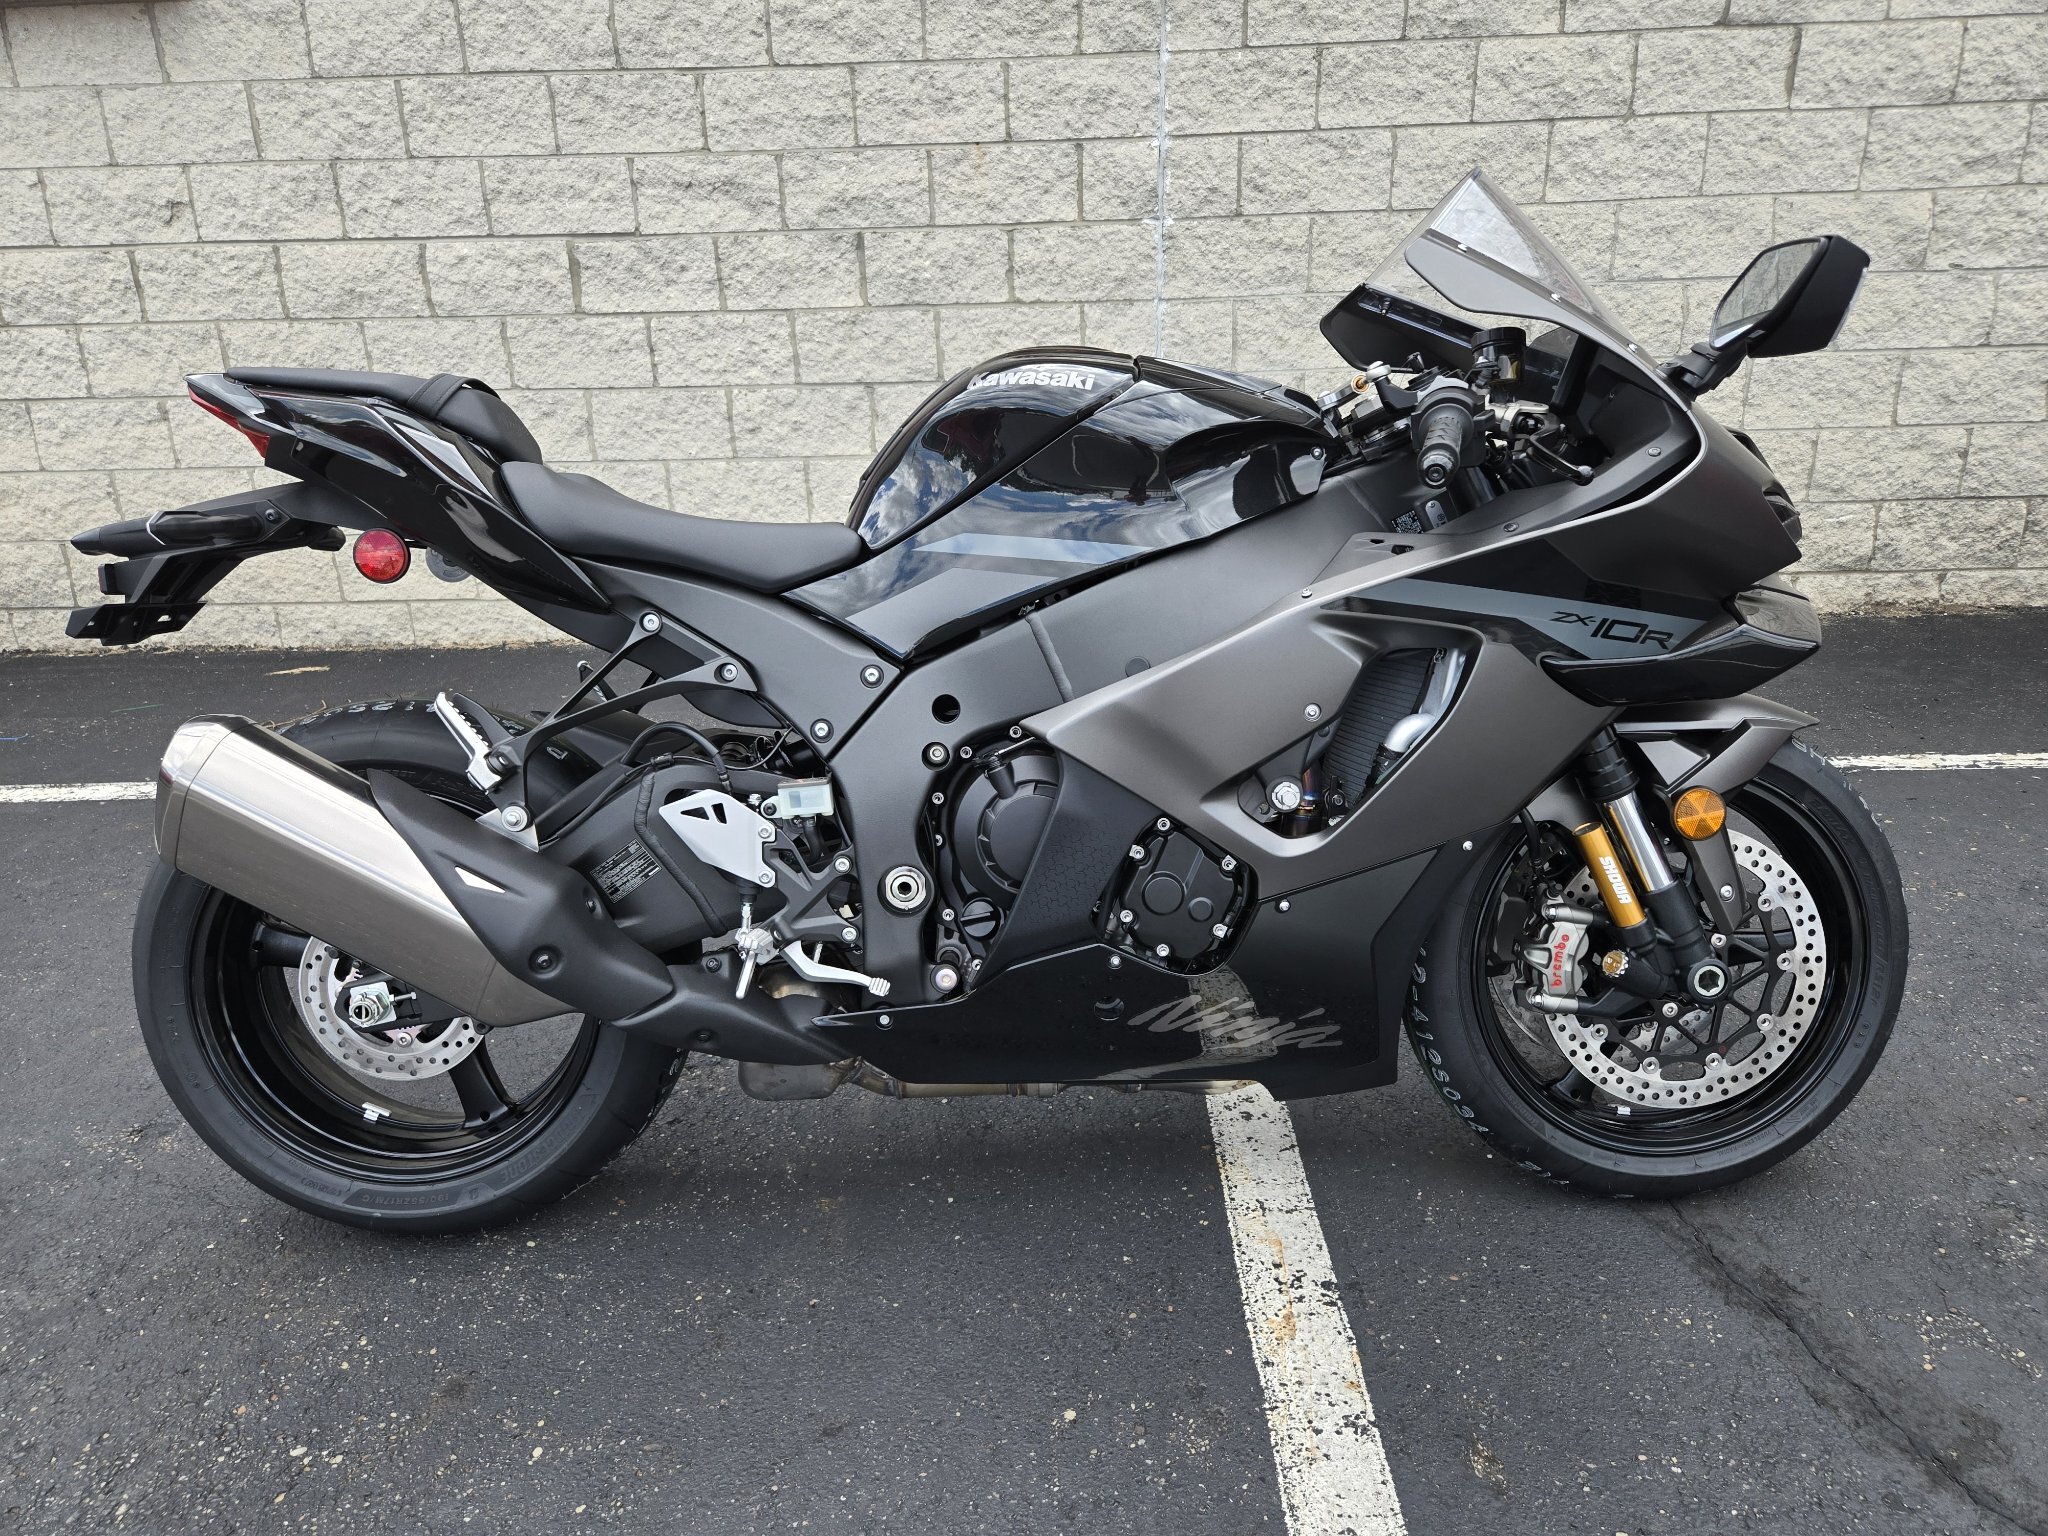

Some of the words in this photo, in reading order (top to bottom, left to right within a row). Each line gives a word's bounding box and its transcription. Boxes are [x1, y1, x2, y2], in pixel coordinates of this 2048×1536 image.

[967, 371, 1096, 391] Kawasaki
[1549, 611, 1674, 650] ZX-10R
[1599, 856, 1632, 904] SHOWA
[1552, 934, 1570, 988] brembo
[1127, 995, 1343, 1050] Ninja
